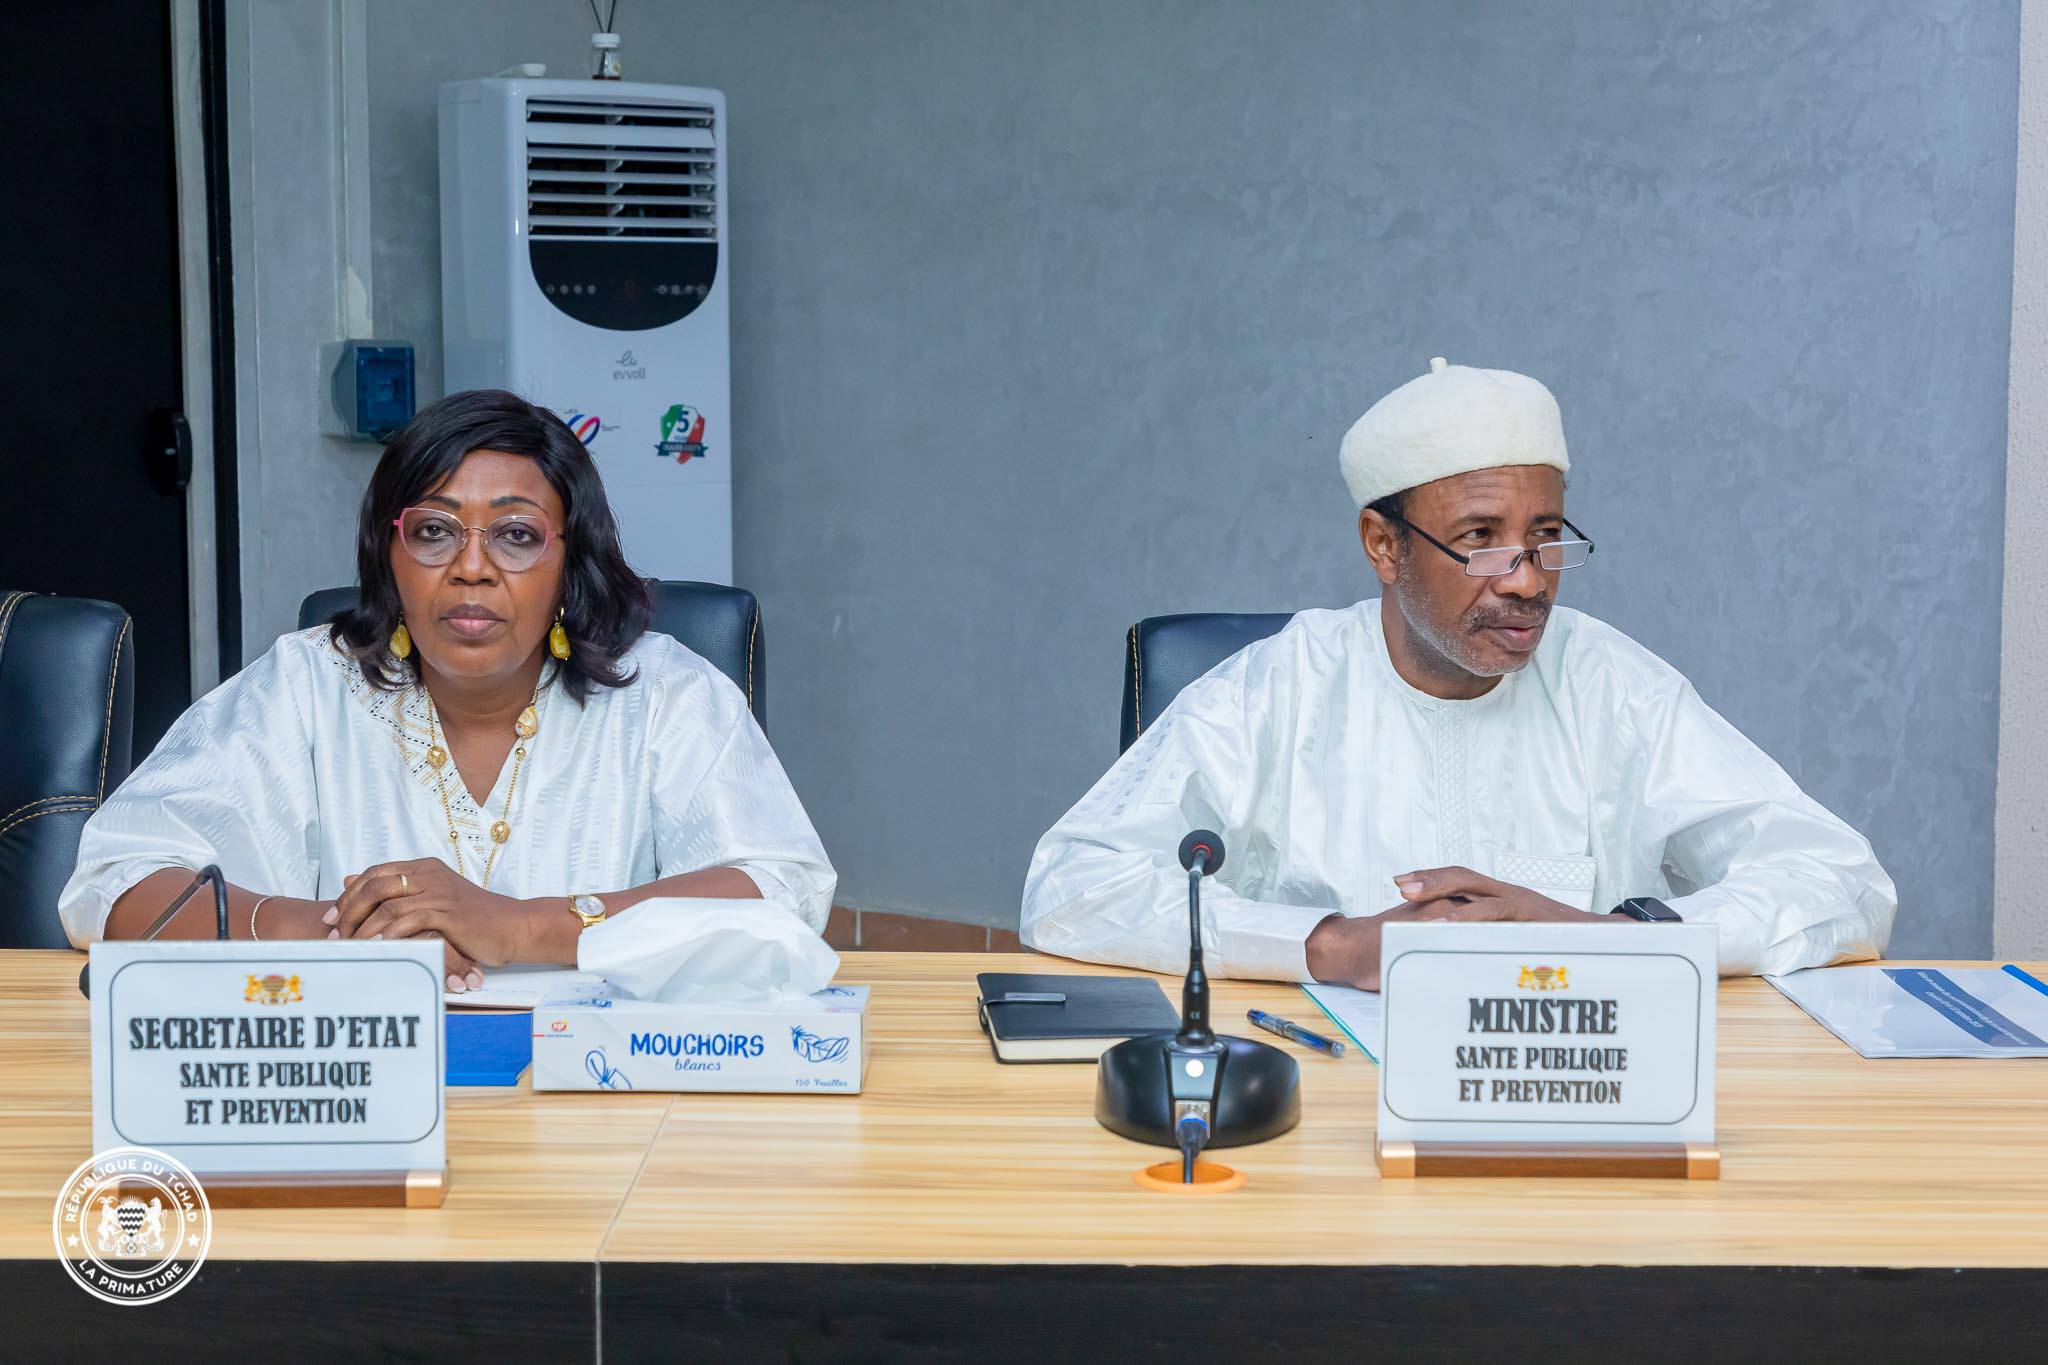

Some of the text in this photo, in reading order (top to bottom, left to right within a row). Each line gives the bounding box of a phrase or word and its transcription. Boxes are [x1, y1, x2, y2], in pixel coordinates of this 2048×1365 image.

[676, 410, 689, 433] 5
[1467, 998, 1618, 1034] MINISTRE
[129, 1016, 305, 1050] SECRETAIRE
[674, 1058, 721, 1072] blancs
[1456, 1046, 1628, 1074] SANTE PUBLIQUE
[180, 1061, 372, 1090] SANTE PUBLIQUE
[1459, 1079, 1622, 1104] ET PREVENTION
[185, 1098, 367, 1125] ET PREVENTION
